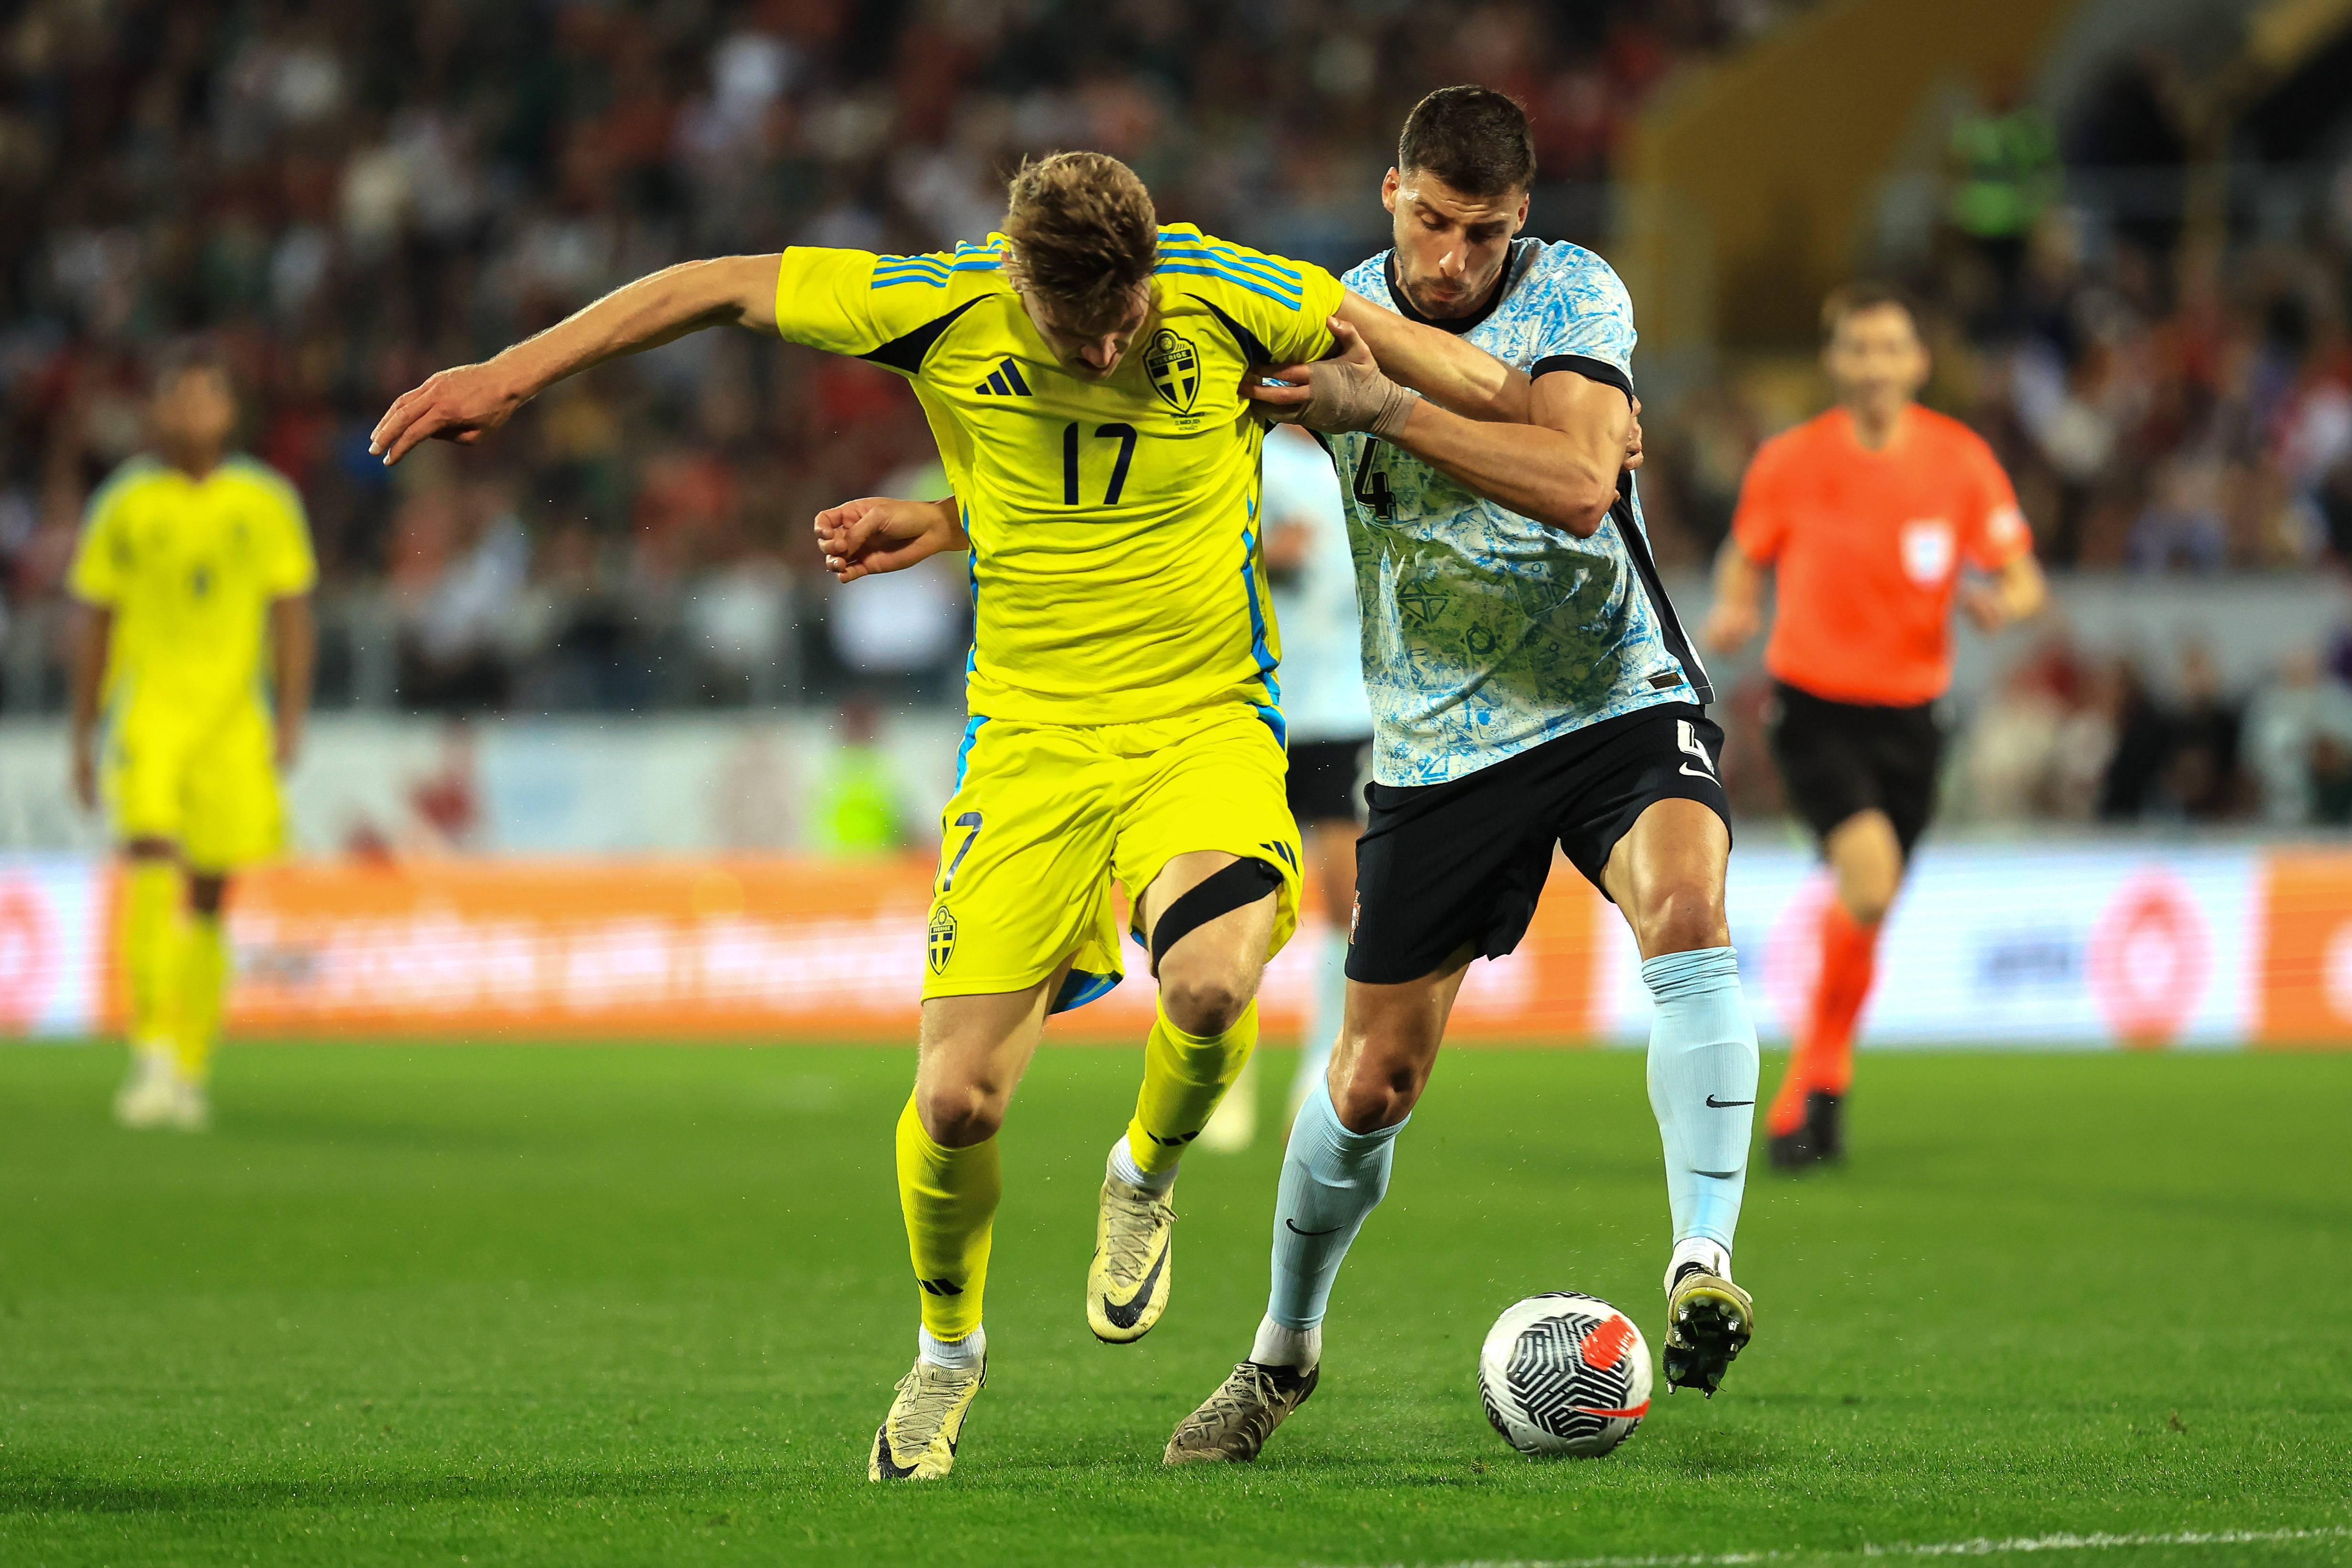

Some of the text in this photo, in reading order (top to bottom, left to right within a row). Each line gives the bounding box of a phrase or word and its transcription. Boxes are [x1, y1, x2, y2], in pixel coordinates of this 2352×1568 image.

[1064, 422, 1137, 505] 17
[1353, 437, 1396, 520] 4
[1677, 719, 1715, 775] 4
[943, 811, 983, 892] 7
